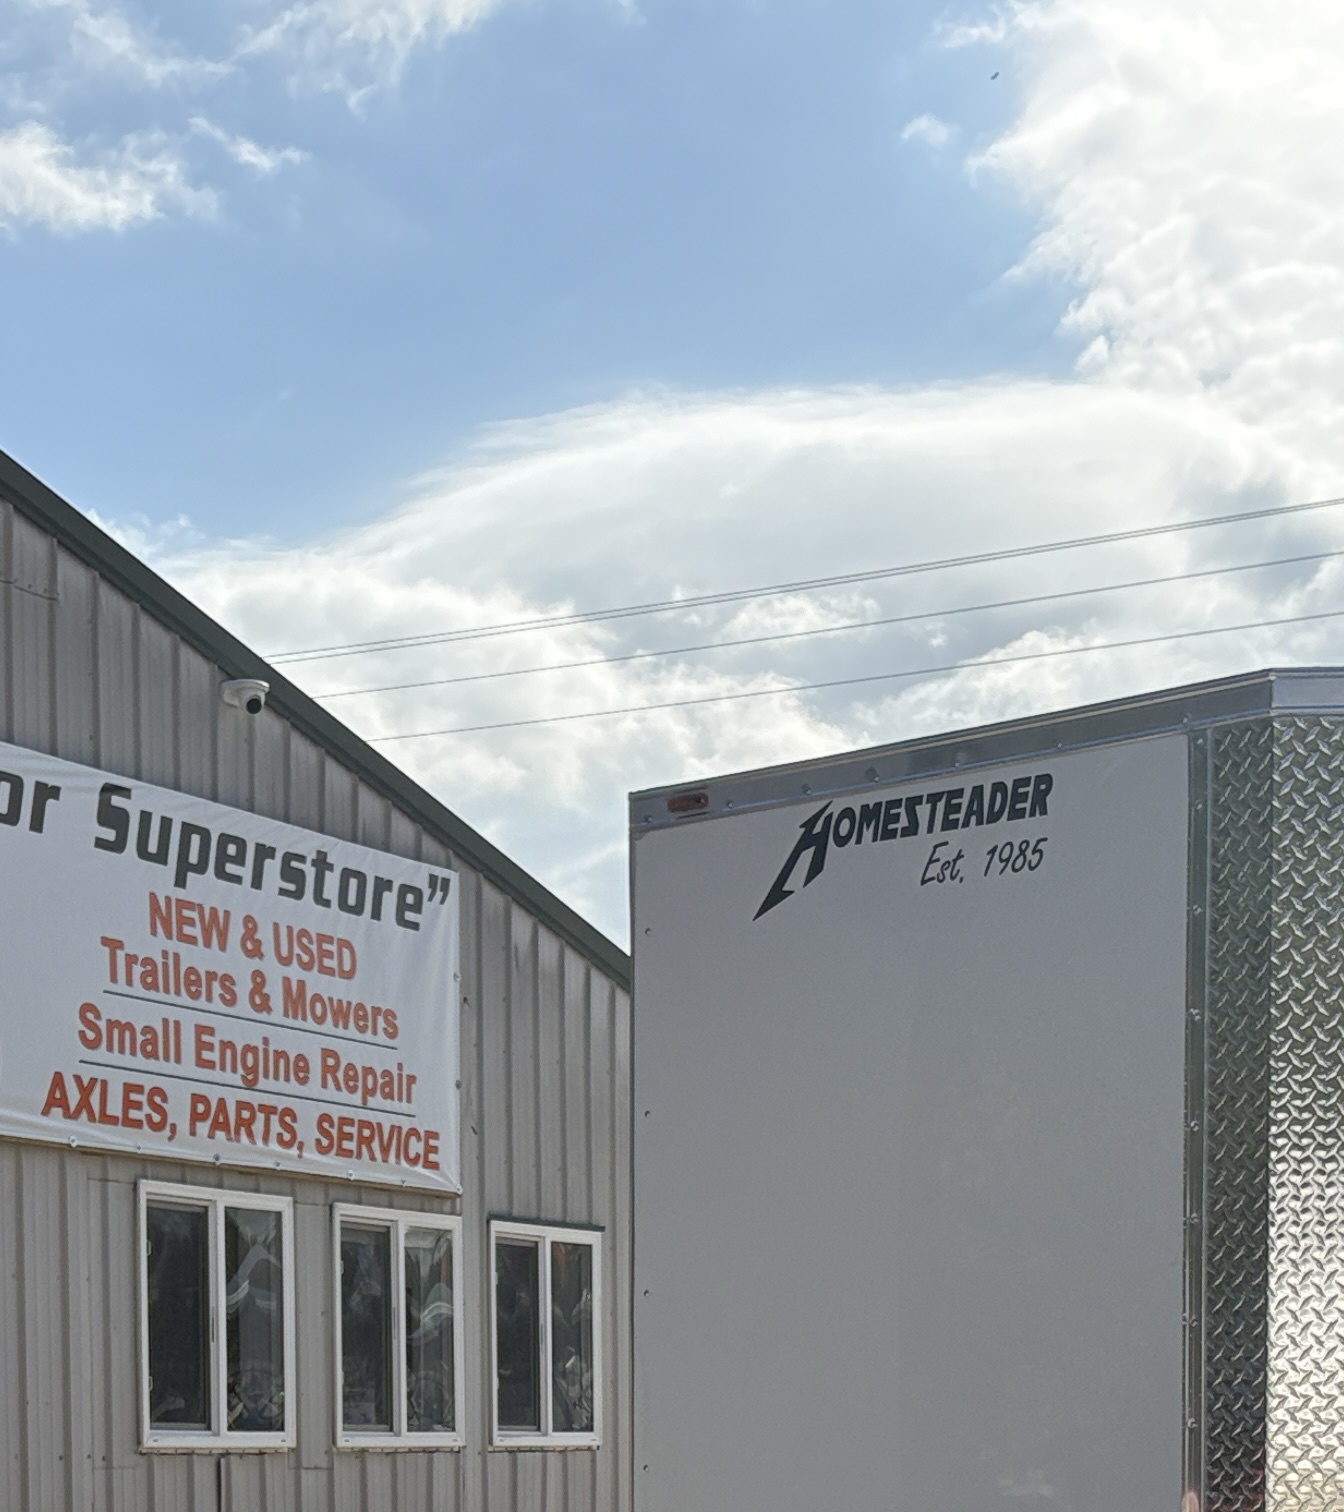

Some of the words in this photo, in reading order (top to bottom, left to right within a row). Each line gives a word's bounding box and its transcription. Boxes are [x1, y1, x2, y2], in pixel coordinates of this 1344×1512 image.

[752, 773, 1053, 921] HOMESTEADER
[920, 841, 964, 887] Est.
[983, 836, 1048, 878] 1985
[149, 892, 230, 952] NEW
[240, 915, 264, 960] &
[274, 922, 356, 980] USED
[101, 936, 237, 1008] Trailers
[249, 969, 272, 1013] &
[282, 976, 399, 1040] Mowers
[78, 1002, 182, 1064] Small
[195, 1024, 310, 1087] Engine
[321, 1048, 416, 1105] Repair
[41, 1072, 177, 1142] AXLES,
[189, 1094, 304, 1158] PARTS,
[315, 1113, 440, 1170] SERVICE
